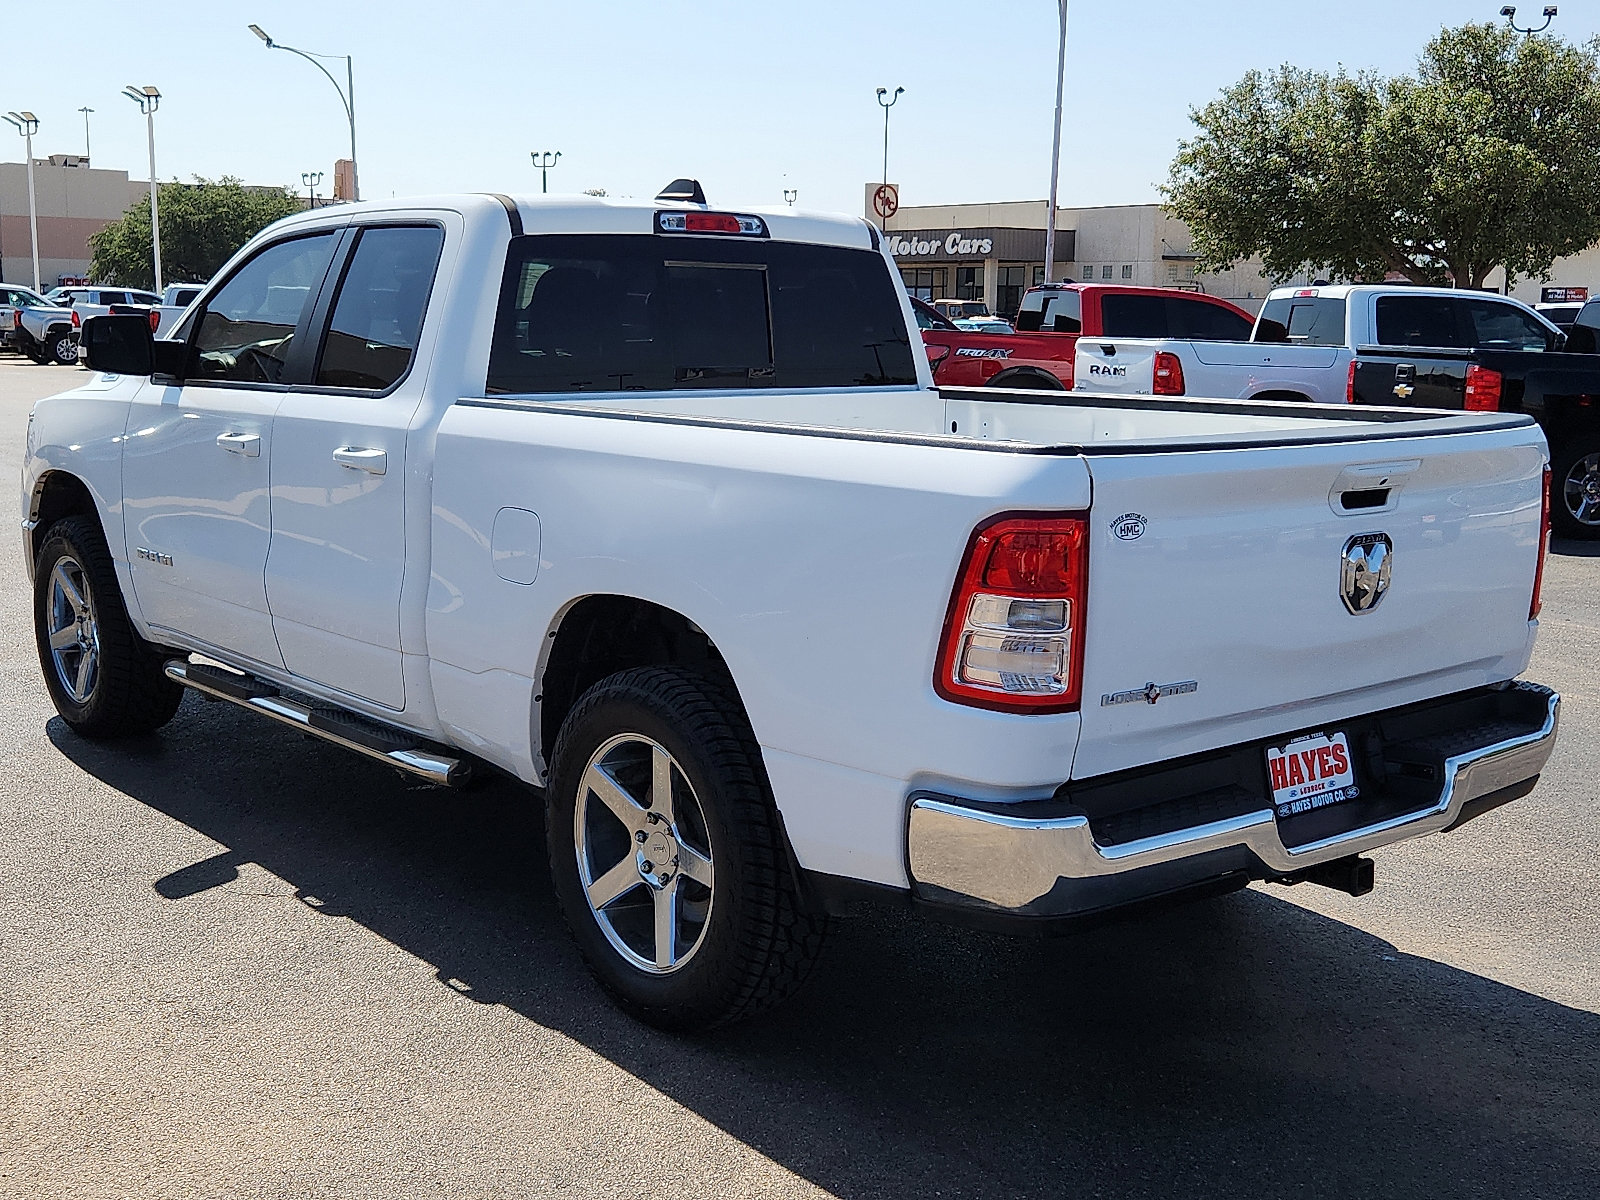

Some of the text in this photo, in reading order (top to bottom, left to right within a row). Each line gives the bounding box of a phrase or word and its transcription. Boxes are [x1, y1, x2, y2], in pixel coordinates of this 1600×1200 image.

[944, 233, 993, 255] Cars
[1090, 364, 1127, 376] RAM
[1119, 522, 1140, 537] HMC
[1270, 743, 1348, 790] HAYES
[1291, 798, 1311, 813] HAYES
[1311, 792, 1334, 807] MOTOR
